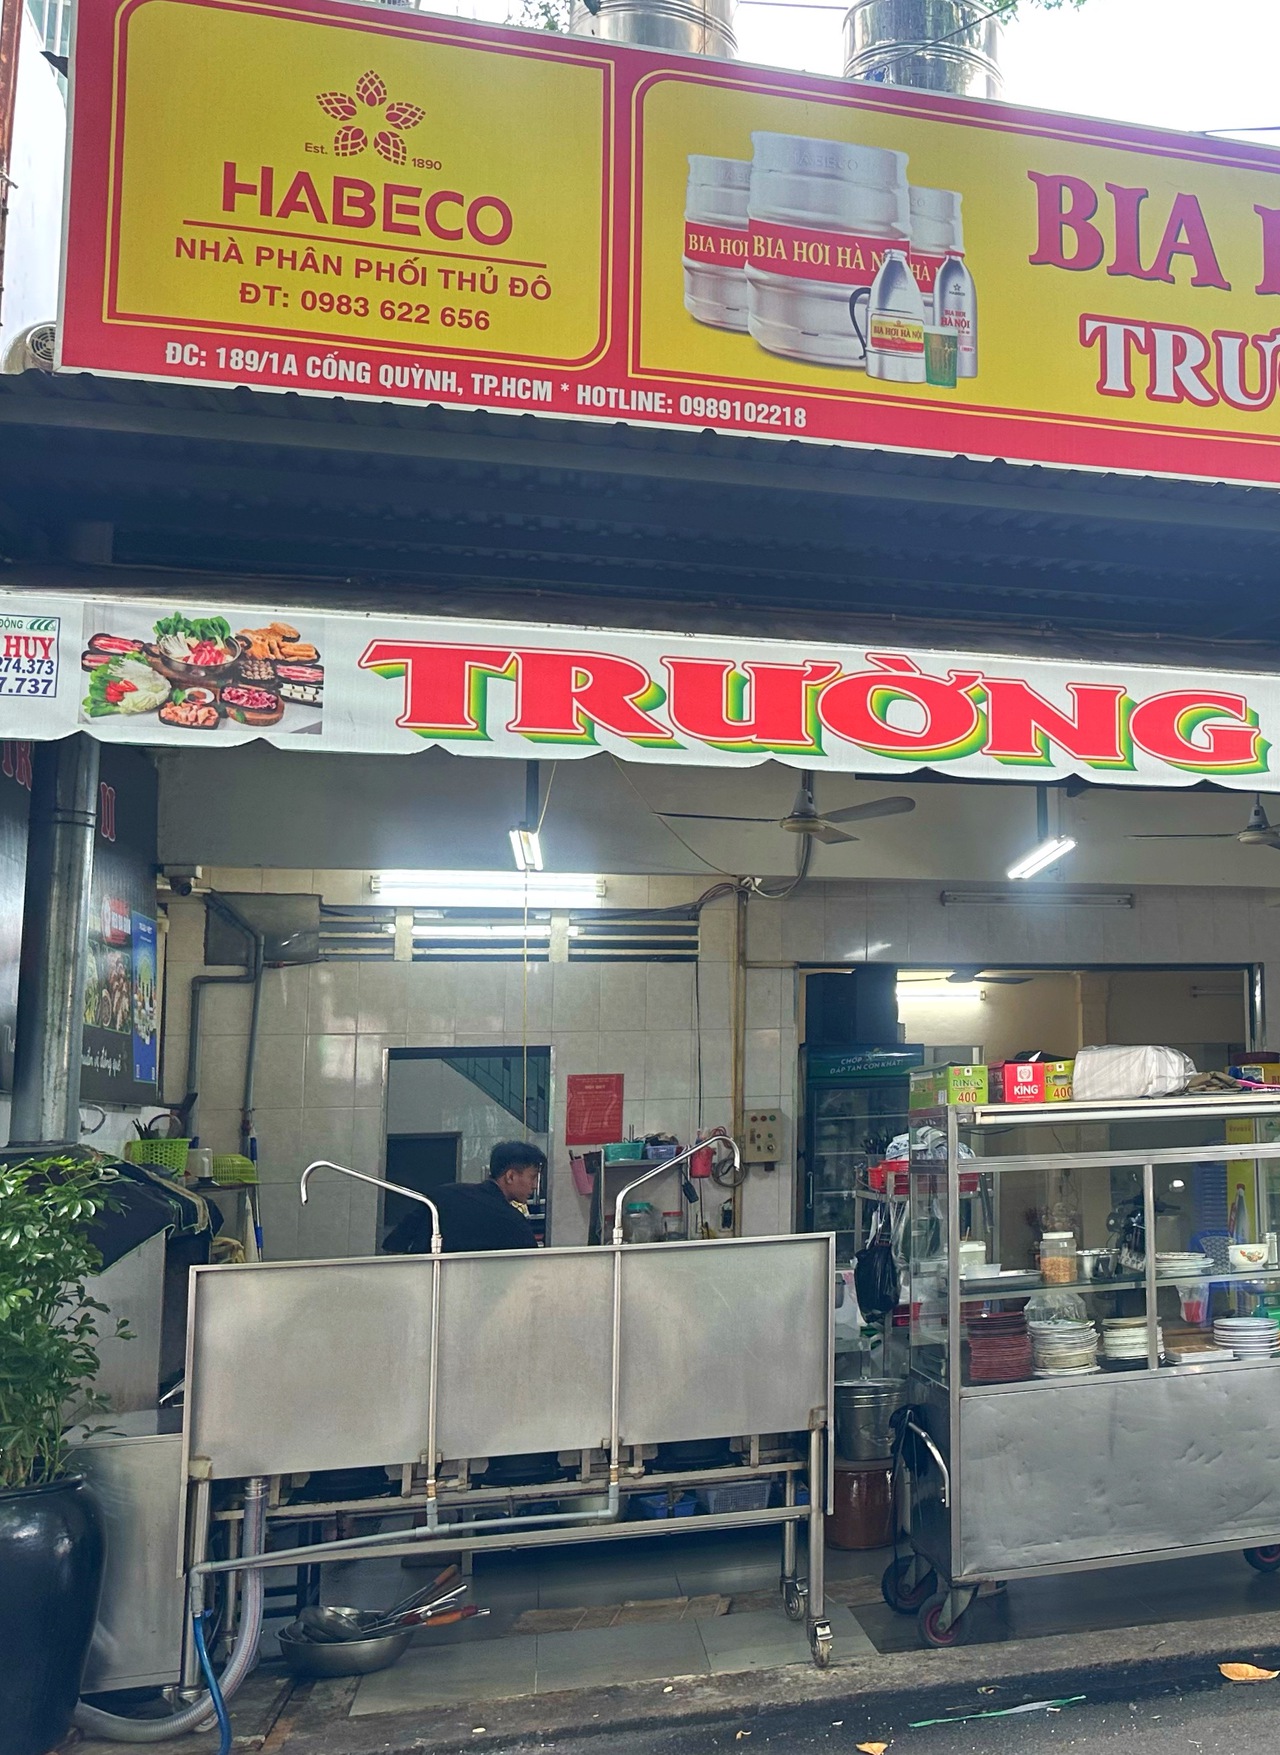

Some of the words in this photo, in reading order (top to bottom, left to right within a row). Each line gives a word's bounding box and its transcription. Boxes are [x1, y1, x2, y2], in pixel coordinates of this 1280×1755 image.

[305, 142, 328, 155] Est.
[411, 157, 442, 171] 1890
[222, 161, 513, 246] HABECO
[688, 234, 716, 252] BIA
[1027, 170, 1231, 291] BIA
[175, 236, 244, 265] NHÀ
[255, 245, 342, 276] PHÂN
[355, 257, 427, 287] PHỐI
[437, 265, 499, 295] THỦ
[508, 274, 552, 301] ĐÔ
[753, 235, 788, 261] BIA
[793, 240, 830, 266] HƠI
[837, 242, 866, 271] HÀ
[239, 282, 290, 308] ĐT:
[300, 289, 370, 317] 0983
[379, 299, 430, 325] 622
[440, 306, 491, 331] 656
[166, 341, 207, 367] ĐC:
[216, 347, 298, 376] 189/1A
[306, 351, 371, 384] CỐNG
[379, 363, 463, 396] QUỲNH,
[471, 373, 553, 401] TP.HCM
[577, 384, 673, 414] HOTLINE:
[679, 395, 807, 428] 0989102218
[3, 634, 55, 660] HUY
[358, 638, 1271, 775] TRƯỜNG
[957, 1091, 978, 1103] 400
[1053, 1086, 1073, 1099] 400
